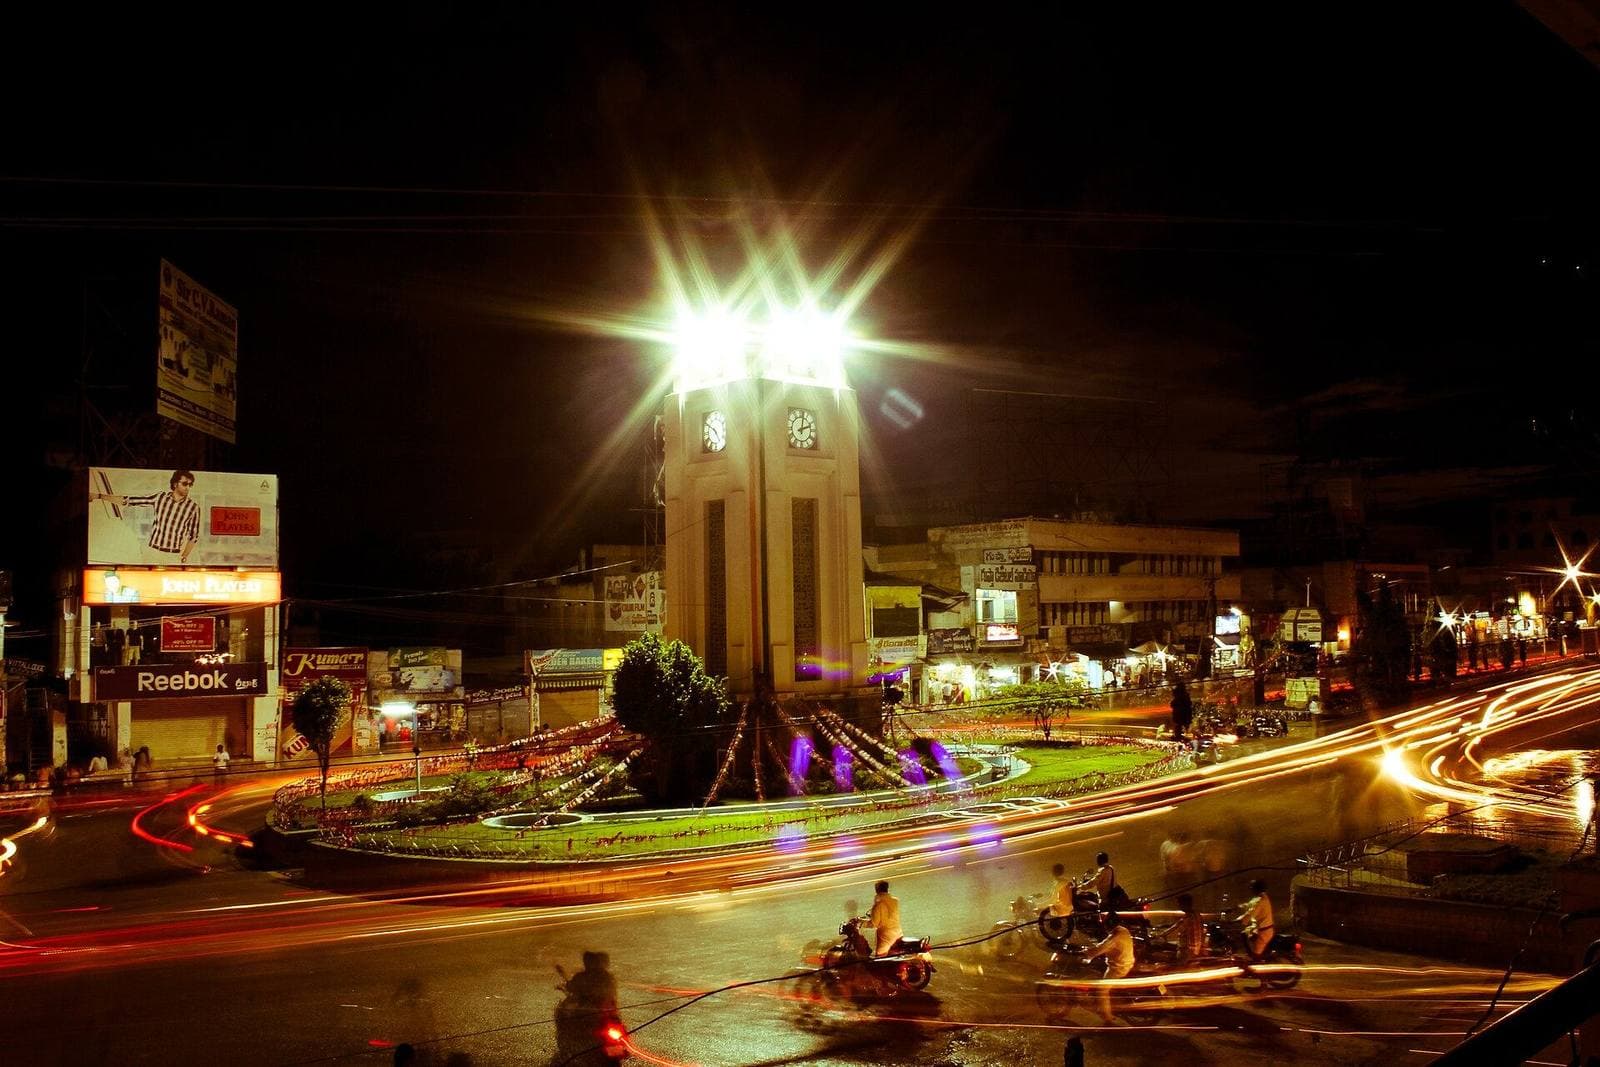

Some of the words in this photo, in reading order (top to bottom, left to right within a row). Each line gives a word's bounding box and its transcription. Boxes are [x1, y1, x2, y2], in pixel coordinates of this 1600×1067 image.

[224, 509, 249, 521] JOHN
[217, 520, 256, 532] PLAYERS
[160, 577, 201, 595] JOHN
[204, 577, 262, 593] PLAYERS
[284, 653, 364, 676] Kumar
[137, 670, 229, 692] Reebok
